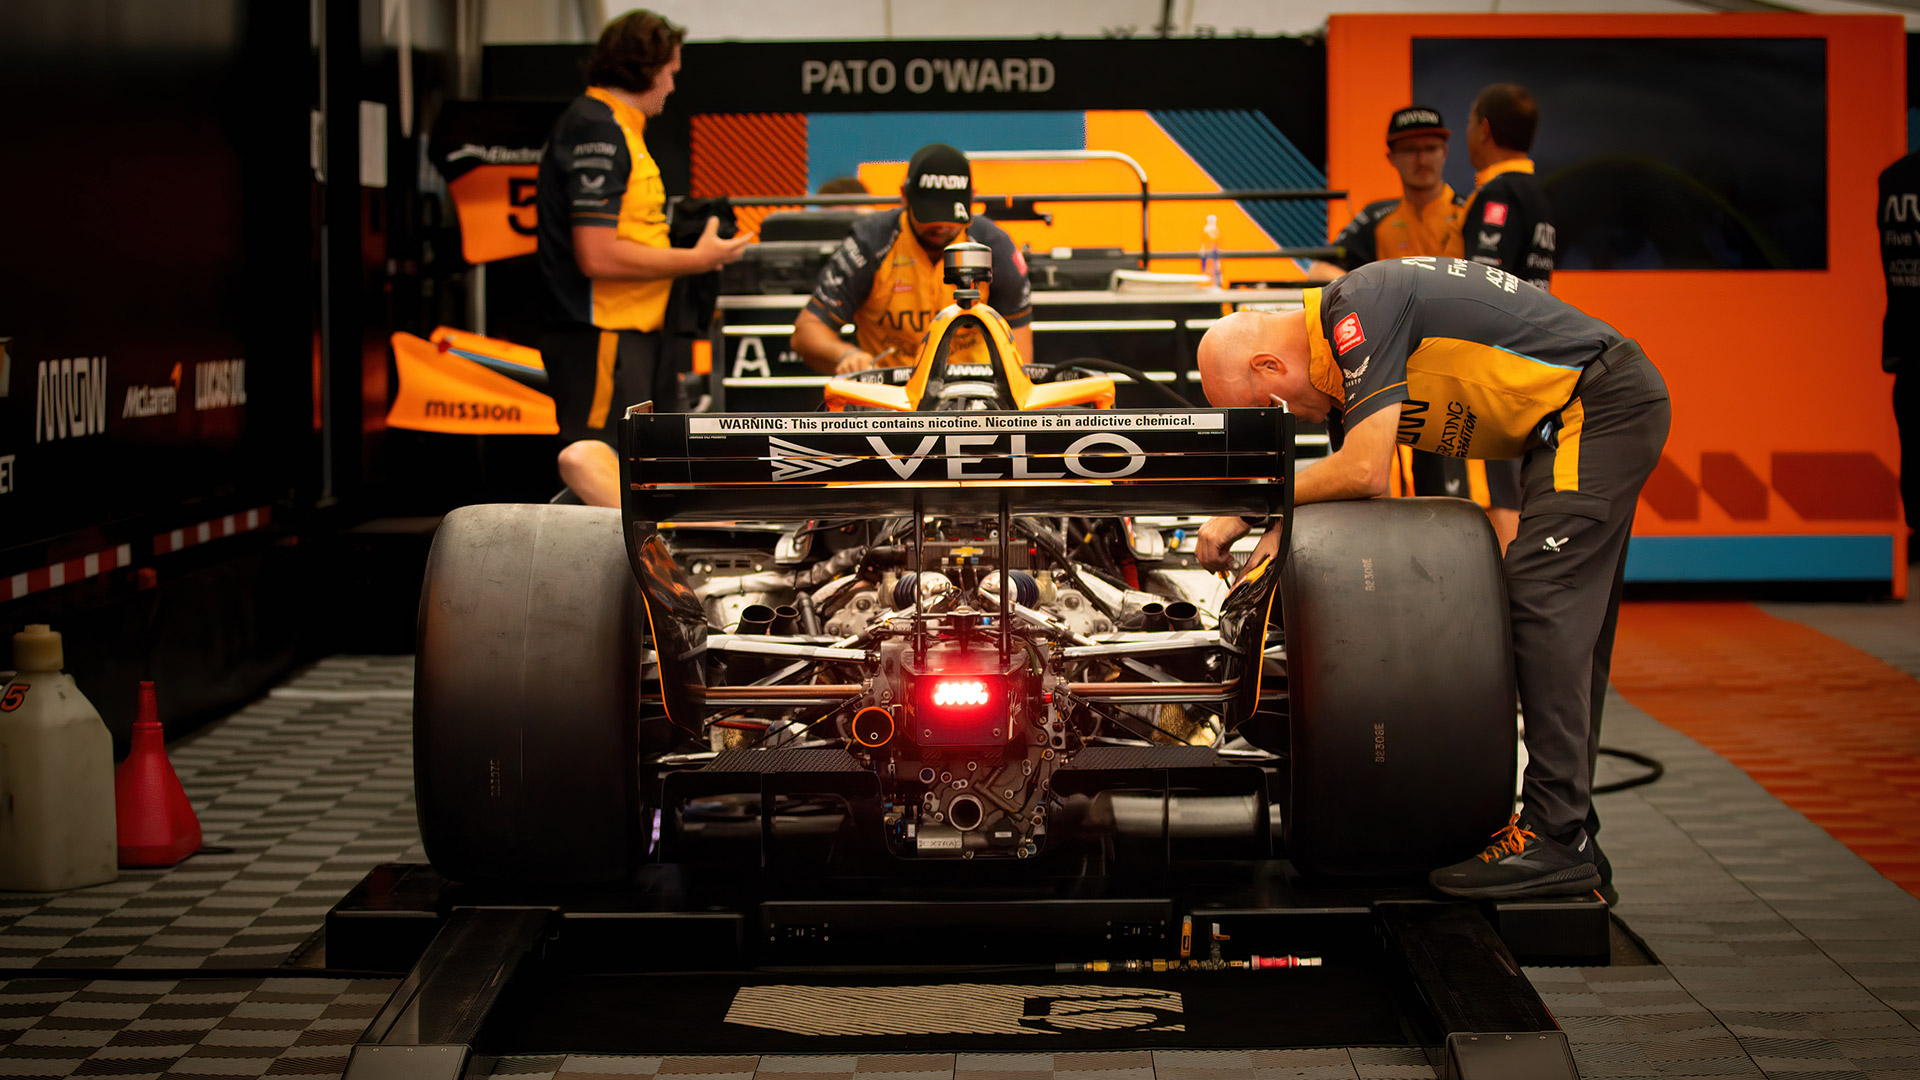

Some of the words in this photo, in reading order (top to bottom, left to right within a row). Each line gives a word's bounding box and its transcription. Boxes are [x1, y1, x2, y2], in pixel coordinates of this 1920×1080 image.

[801, 58, 897, 94] PATO
[904, 58, 1056, 93] O'WARD
[508, 179, 538, 235] 5
[733, 337, 770, 377] A
[425, 400, 521, 422] mission
[719, 419, 788, 430] WARNING:
[791, 418, 818, 430] This
[821, 418, 868, 431] product
[871, 418, 925, 429] contains
[928, 417, 982, 429] nicotine.
[985, 416, 1038, 428] Nicotine
[1041, 416, 1053, 427] is
[1056, 418, 1071, 427] an
[1075, 416, 1132, 427] addictive
[1135, 415, 1196, 426] chemical.
[866, 433, 1146, 480] VELO
[0, 683, 31, 712] 5
